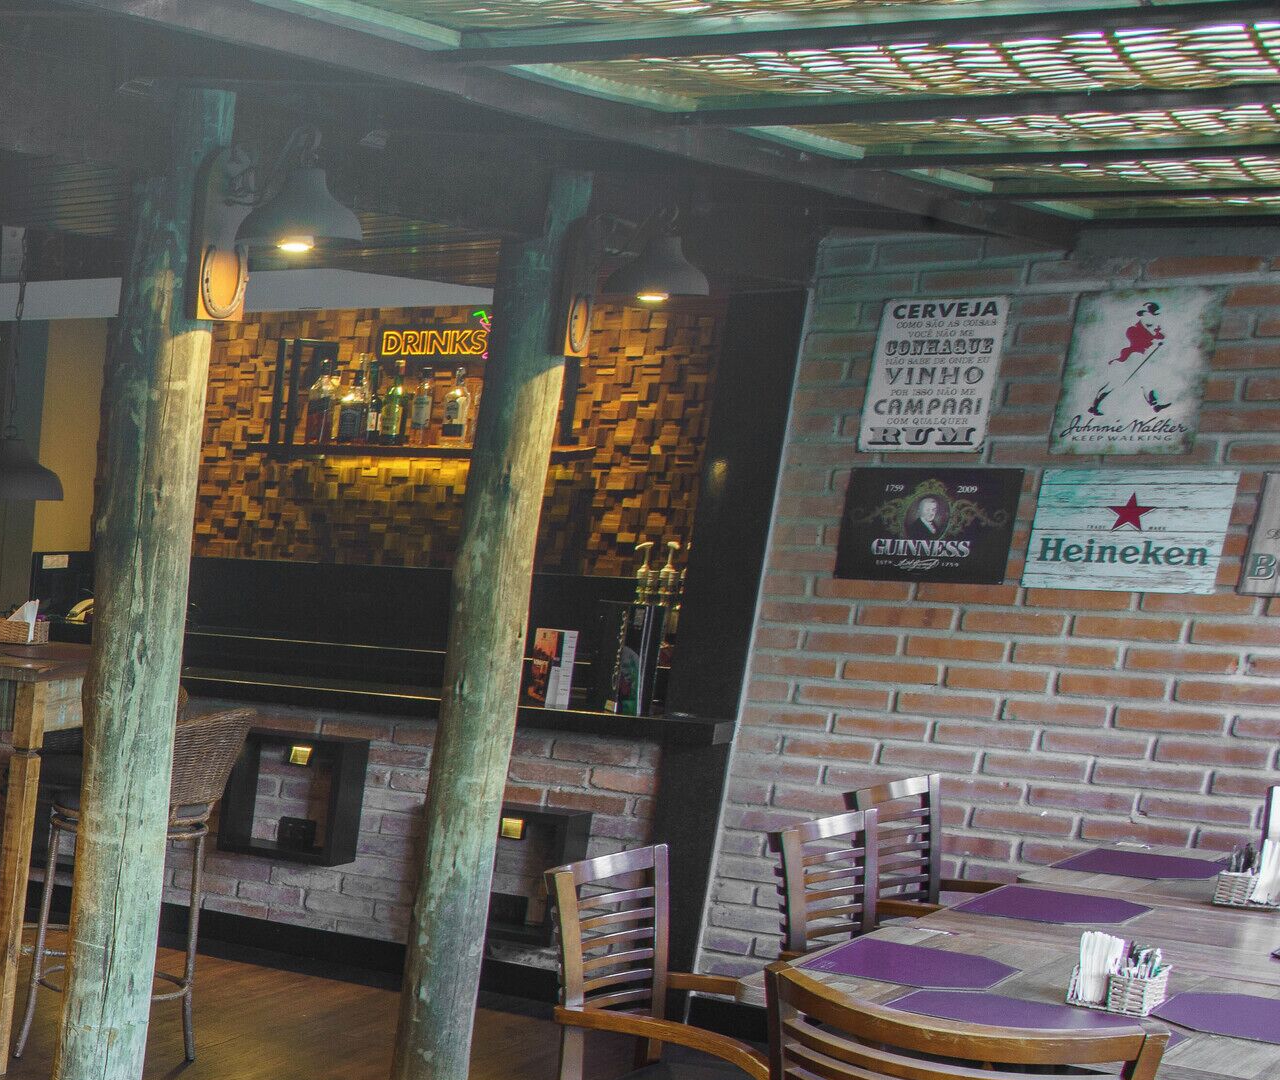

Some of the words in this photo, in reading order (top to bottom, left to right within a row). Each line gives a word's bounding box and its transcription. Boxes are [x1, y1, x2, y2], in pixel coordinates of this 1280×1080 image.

[892, 301, 999, 319] CERVEJA
[896, 320, 923, 329] COMO
[925, 319, 945, 328] SÃO
[947, 320, 960, 328] AS
[963, 319, 997, 327] COISAS
[908, 329, 933, 338] VOCÊ
[936, 328, 957, 337] NÃO
[960, 329, 975, 337] ME
[381, 329, 488, 356] DRINKS
[884, 338, 995, 356] CONHAQUE
[885, 366, 985, 385] VINHO
[890, 388, 909, 396] POR
[911, 388, 934, 396] ISSO
[936, 386, 957, 396] NÃO
[960, 388, 976, 396] ME
[874, 397, 983, 416] CAMPARI
[886, 417, 909, 426] COM
[912, 417, 969, 426] QUALQUER
[1060, 414, 1124, 437] Johnnie
[1126, 416, 1189, 434] Walker
[867, 426, 977, 446] RUM
[1107, 434, 1173, 442] WALKING
[885, 484, 905, 492] 1759
[957, 485, 978, 493] 2009
[870, 538, 971, 558] GUINNESS
[1036, 537, 1208, 566] Heineken
